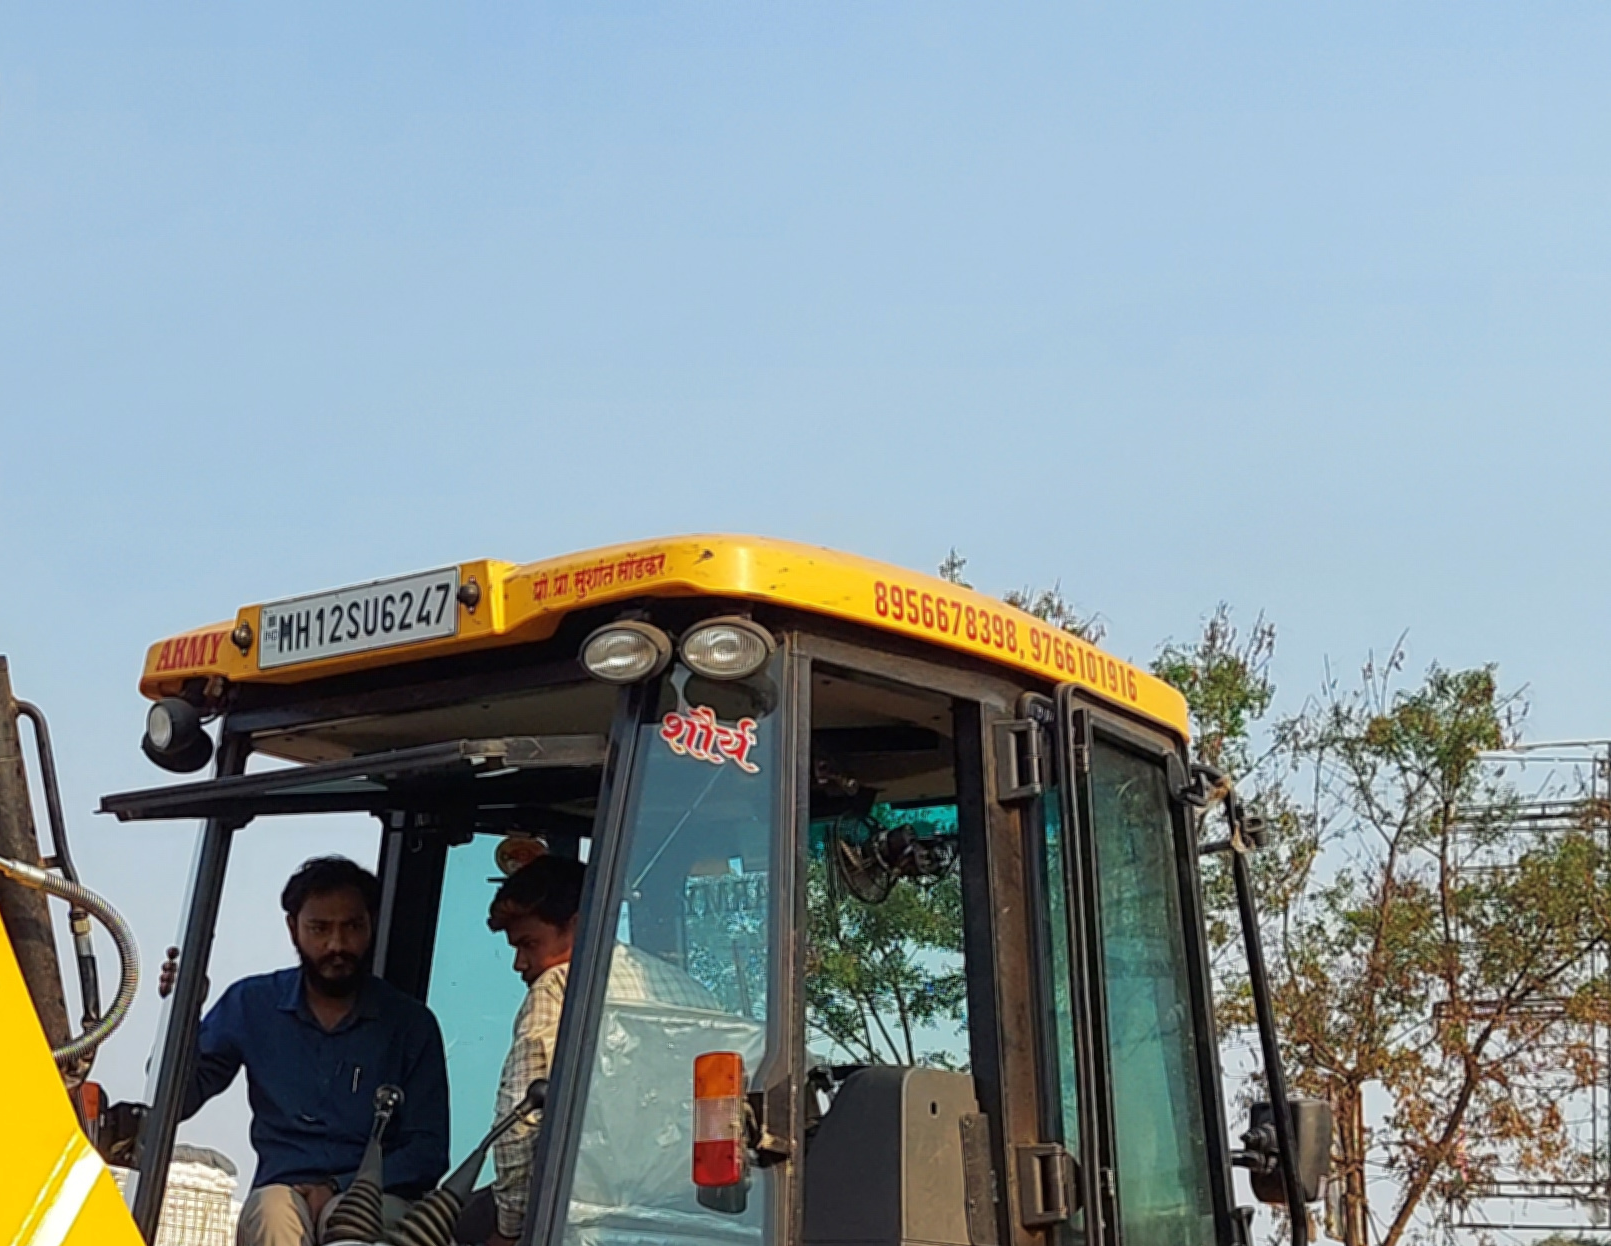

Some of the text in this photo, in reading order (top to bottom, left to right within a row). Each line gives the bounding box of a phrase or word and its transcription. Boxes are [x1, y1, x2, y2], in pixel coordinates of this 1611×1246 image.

[156, 631, 226, 671] ARMY
[277, 583, 451, 653] MH12SU6247
[1030, 630, 1138, 701] 9766101916
